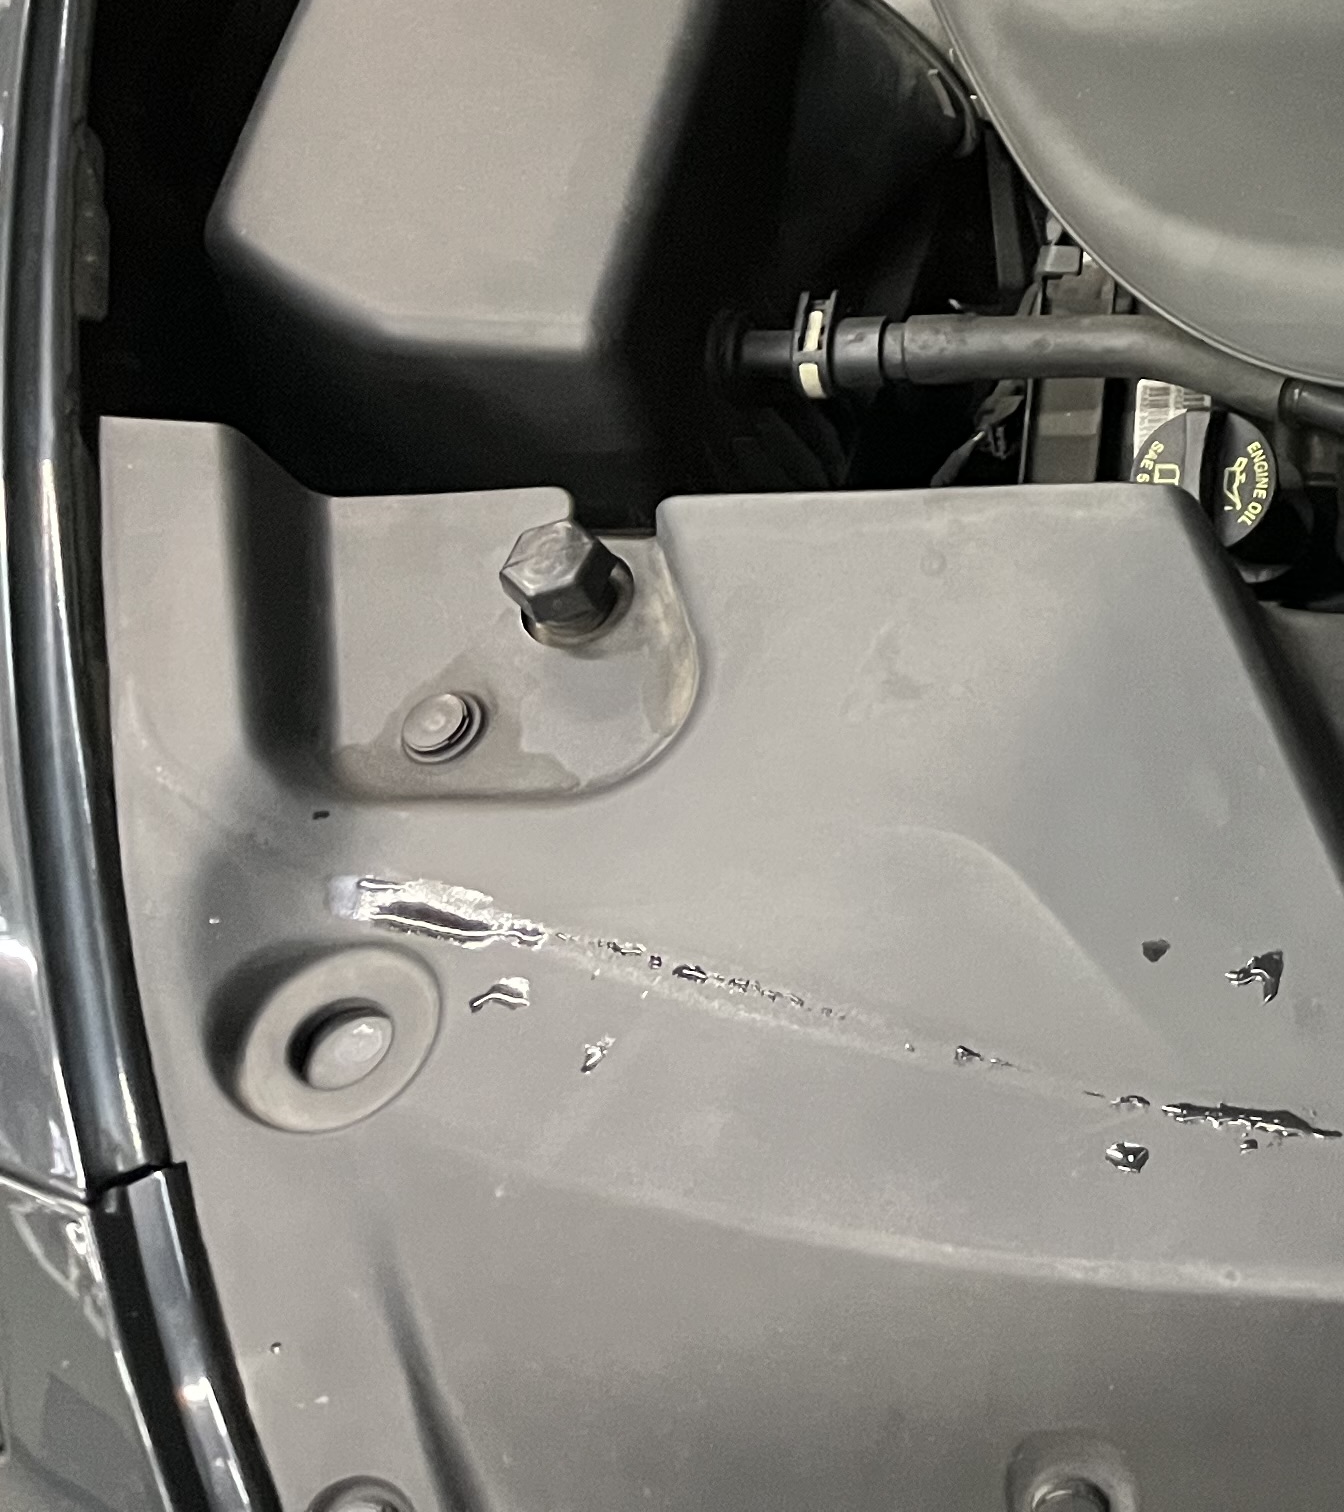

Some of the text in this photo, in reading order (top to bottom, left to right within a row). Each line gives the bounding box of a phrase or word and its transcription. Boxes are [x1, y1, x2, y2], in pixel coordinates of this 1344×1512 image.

[1140, 441, 1164, 470] SAE
[1237, 441, 1269, 526] ENGINE OIL
